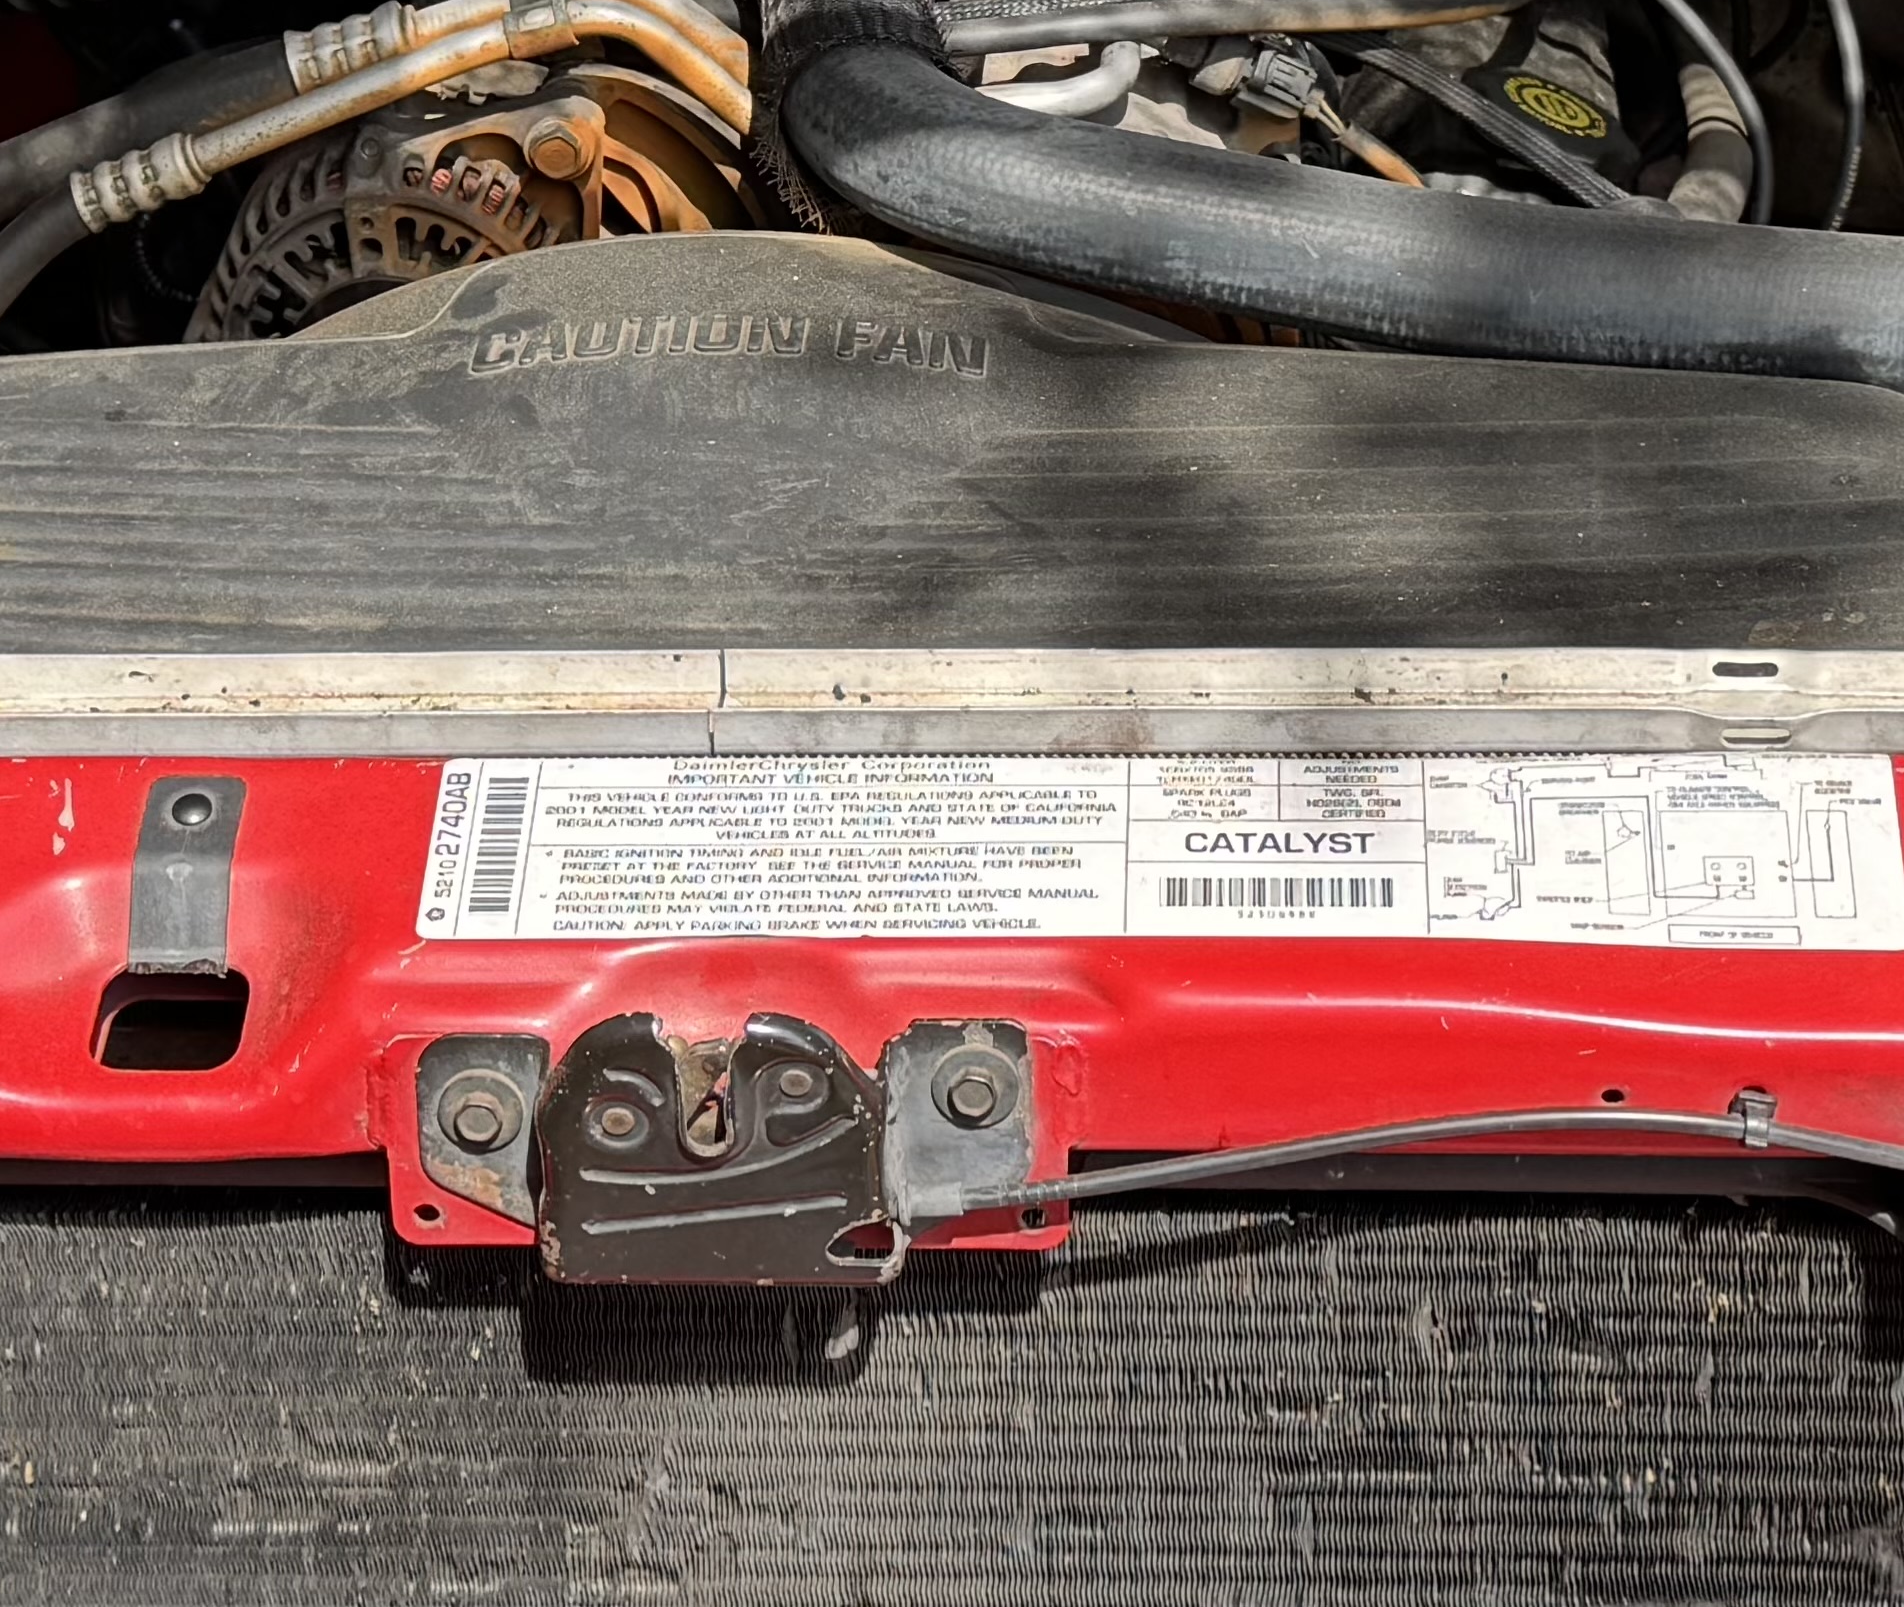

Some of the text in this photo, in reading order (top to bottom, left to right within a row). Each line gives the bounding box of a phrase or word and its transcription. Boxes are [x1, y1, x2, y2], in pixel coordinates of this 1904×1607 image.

[468, 312, 990, 379] CAUTION FAN
[673, 758, 991, 774] DaimlerChrysler Corporation
[668, 773, 994, 785] IMPORTANT VEHICLE INFORMATION
[1325, 774, 1378, 783] NEEDED
[592, 805, 646, 815] MODEL
[1184, 832, 1376, 854] CATALYST
[670, 874, 706, 884] AND
